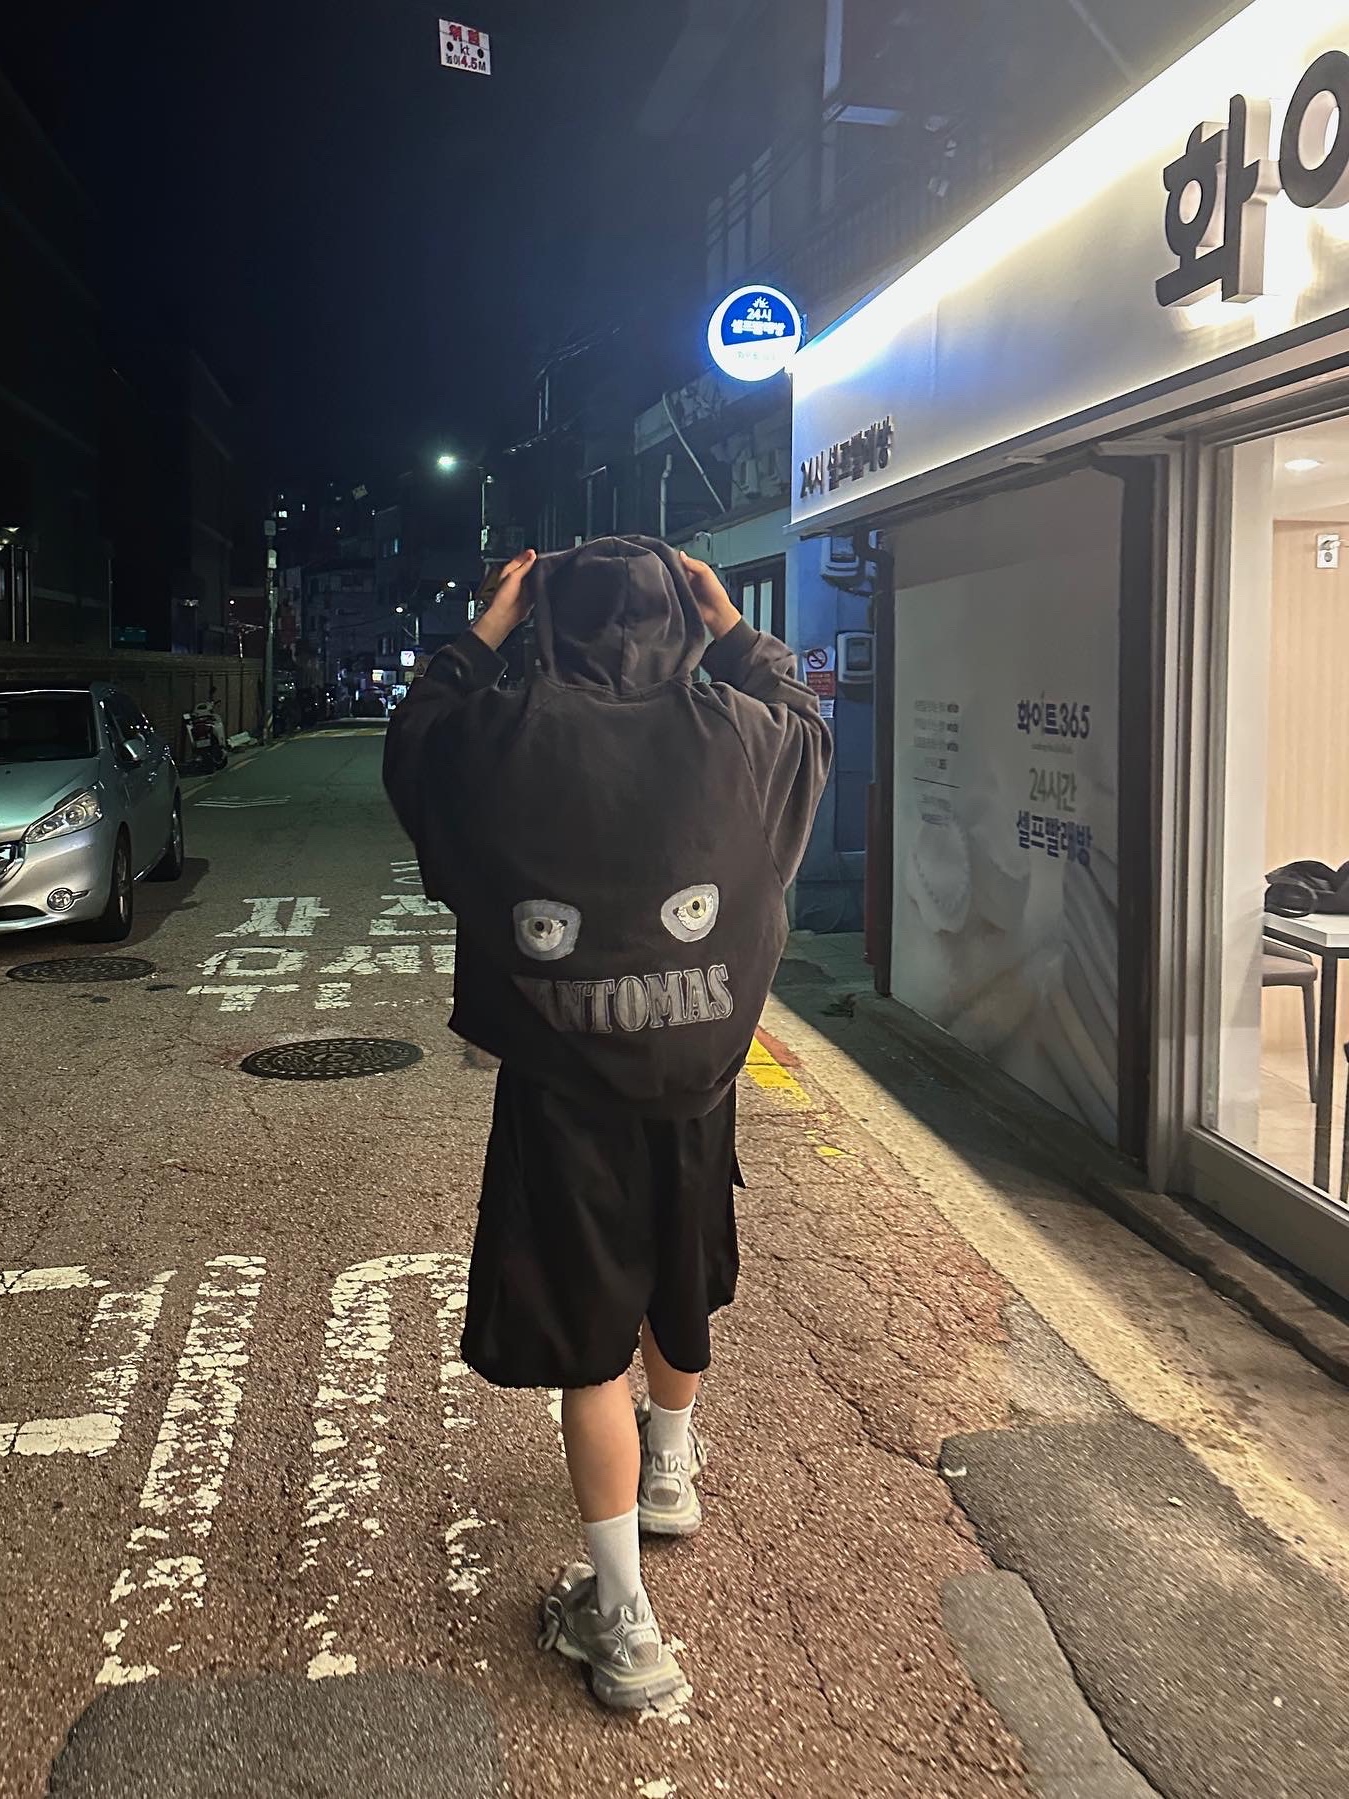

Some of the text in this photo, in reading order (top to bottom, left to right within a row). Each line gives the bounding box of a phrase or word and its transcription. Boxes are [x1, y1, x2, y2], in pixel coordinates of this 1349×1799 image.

[460, 43, 470, 56] kt
[1017, 690, 1091, 740] 화이트365
[1028, 767, 1078, 813] 24시간
[511, 964, 734, 1034] ANTOMAS
